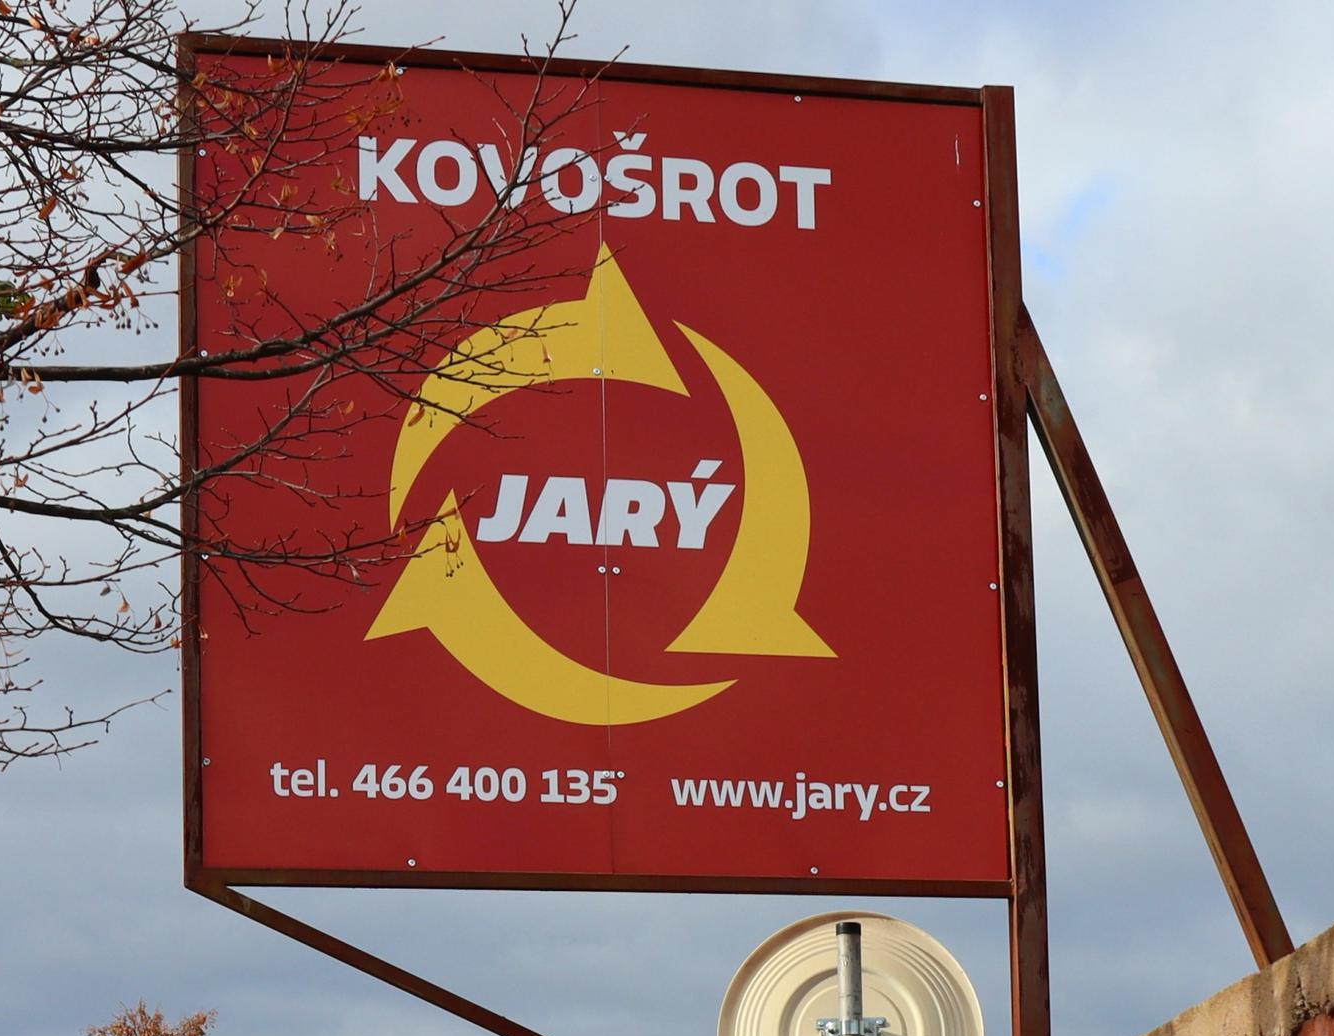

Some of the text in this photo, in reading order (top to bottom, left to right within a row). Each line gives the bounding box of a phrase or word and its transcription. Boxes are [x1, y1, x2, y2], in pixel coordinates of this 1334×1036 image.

[358, 132, 832, 229] KOVOŠROT
[476, 460, 736, 549] JARÝ
[269, 760, 931, 821] tel. 466 400 135 www.jary.cz
